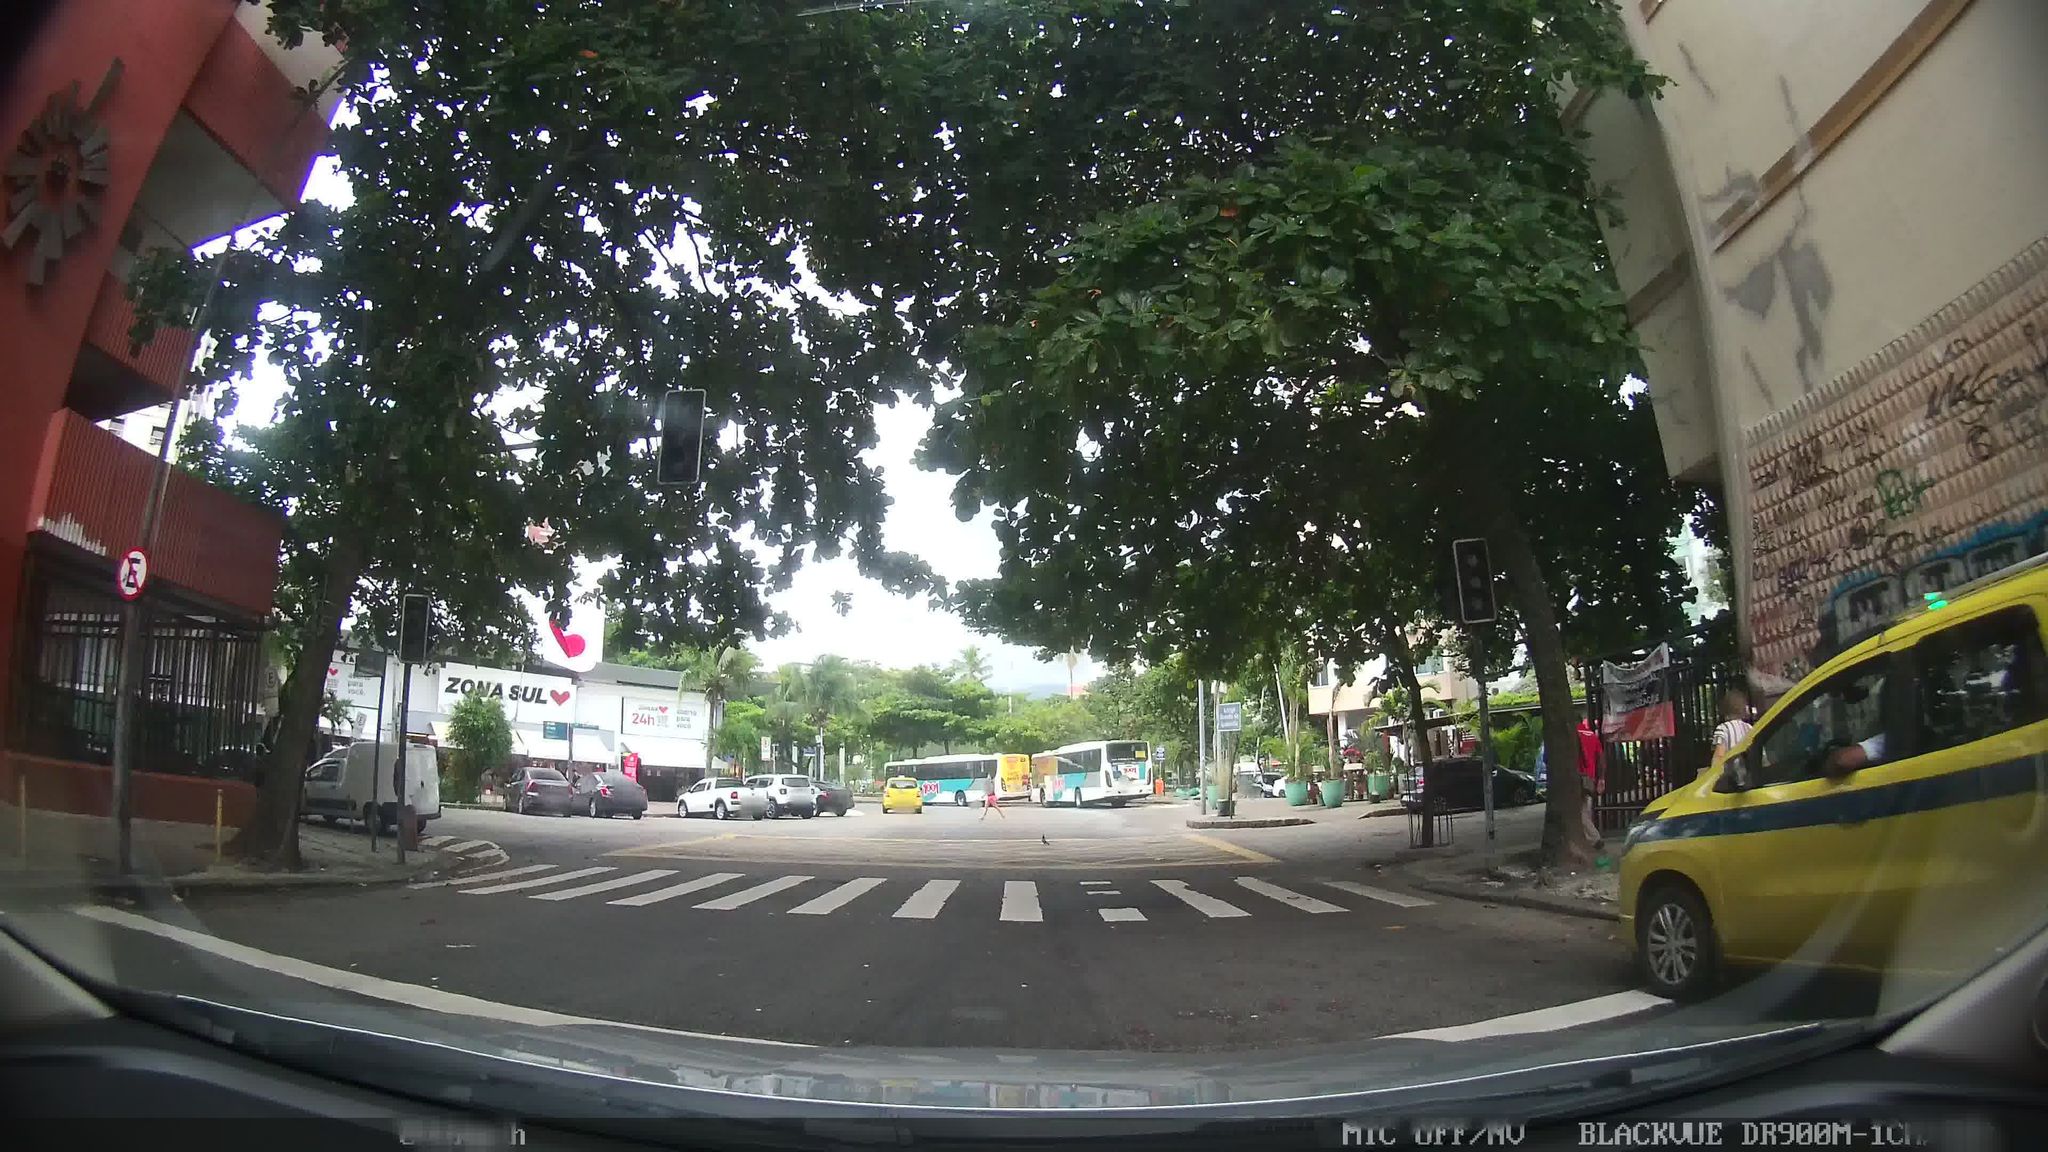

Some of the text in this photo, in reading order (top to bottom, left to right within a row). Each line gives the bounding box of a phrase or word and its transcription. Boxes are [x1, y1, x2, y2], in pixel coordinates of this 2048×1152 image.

[445, 677, 548, 705] ZONA SUL
[632, 712, 655, 726] 24h
